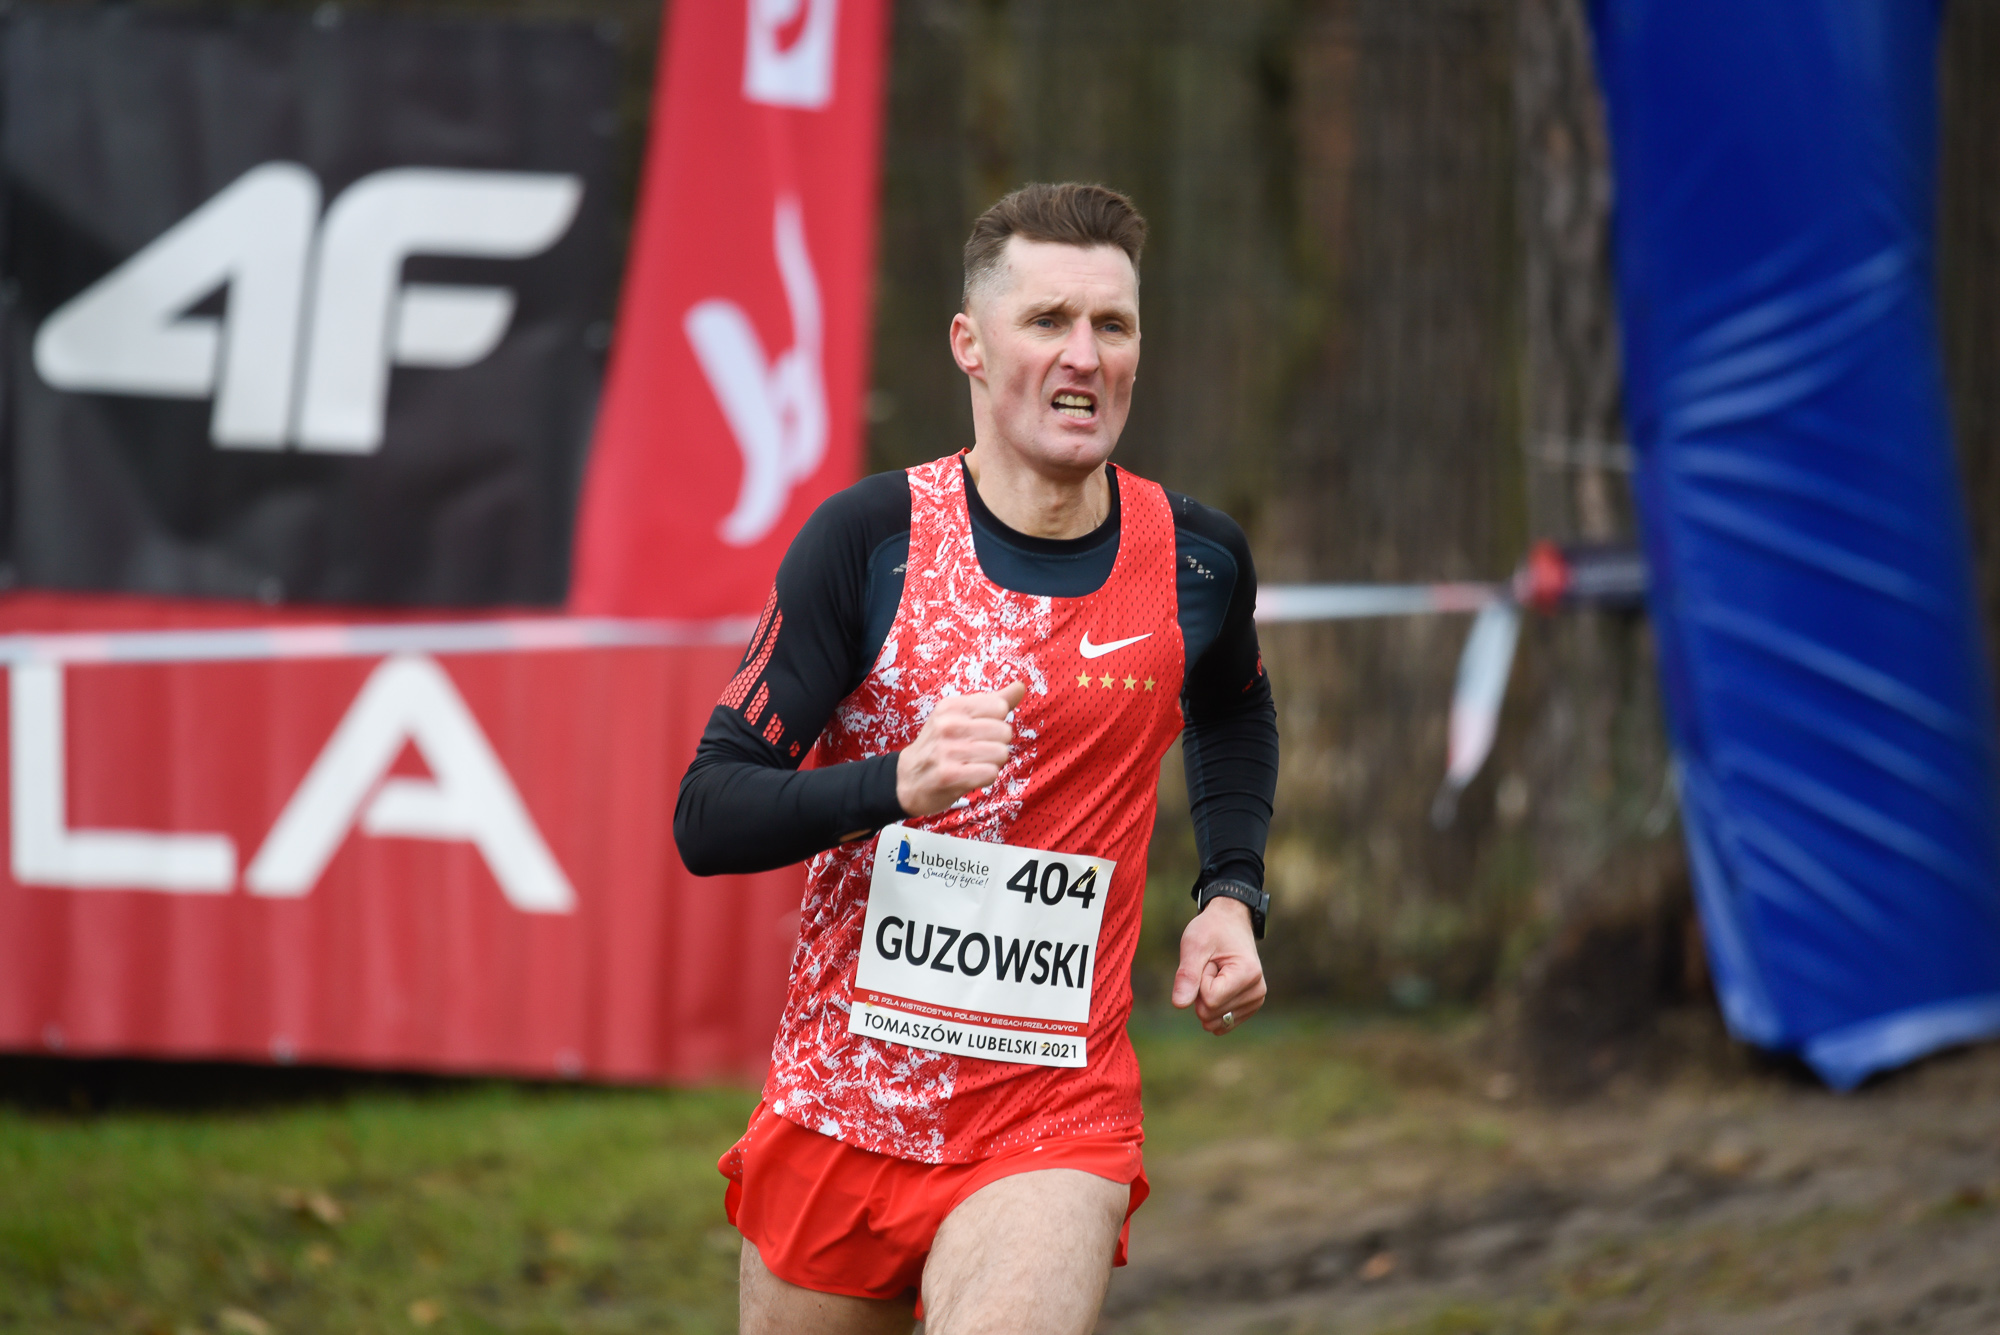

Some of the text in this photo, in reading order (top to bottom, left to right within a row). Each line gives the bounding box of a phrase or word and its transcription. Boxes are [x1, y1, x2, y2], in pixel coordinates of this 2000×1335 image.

[33, 160, 583, 455] 4F
[921, 851, 990, 876] lubelskie
[923, 867, 990, 889] Smakuj życie!
[1006, 859, 1099, 909] 404
[875, 915, 1090, 989] GUZOWSKI
[864, 1012, 1078, 1059] TOMASZÓW LUBELSKI 2021
[881, 997, 900, 1007] PZLA
[900, 1001, 953, 1018] MISTRZOSTWA
[953, 1011, 981, 1022] POLSKI
[991, 1018, 1023, 1028] BIEGACH
